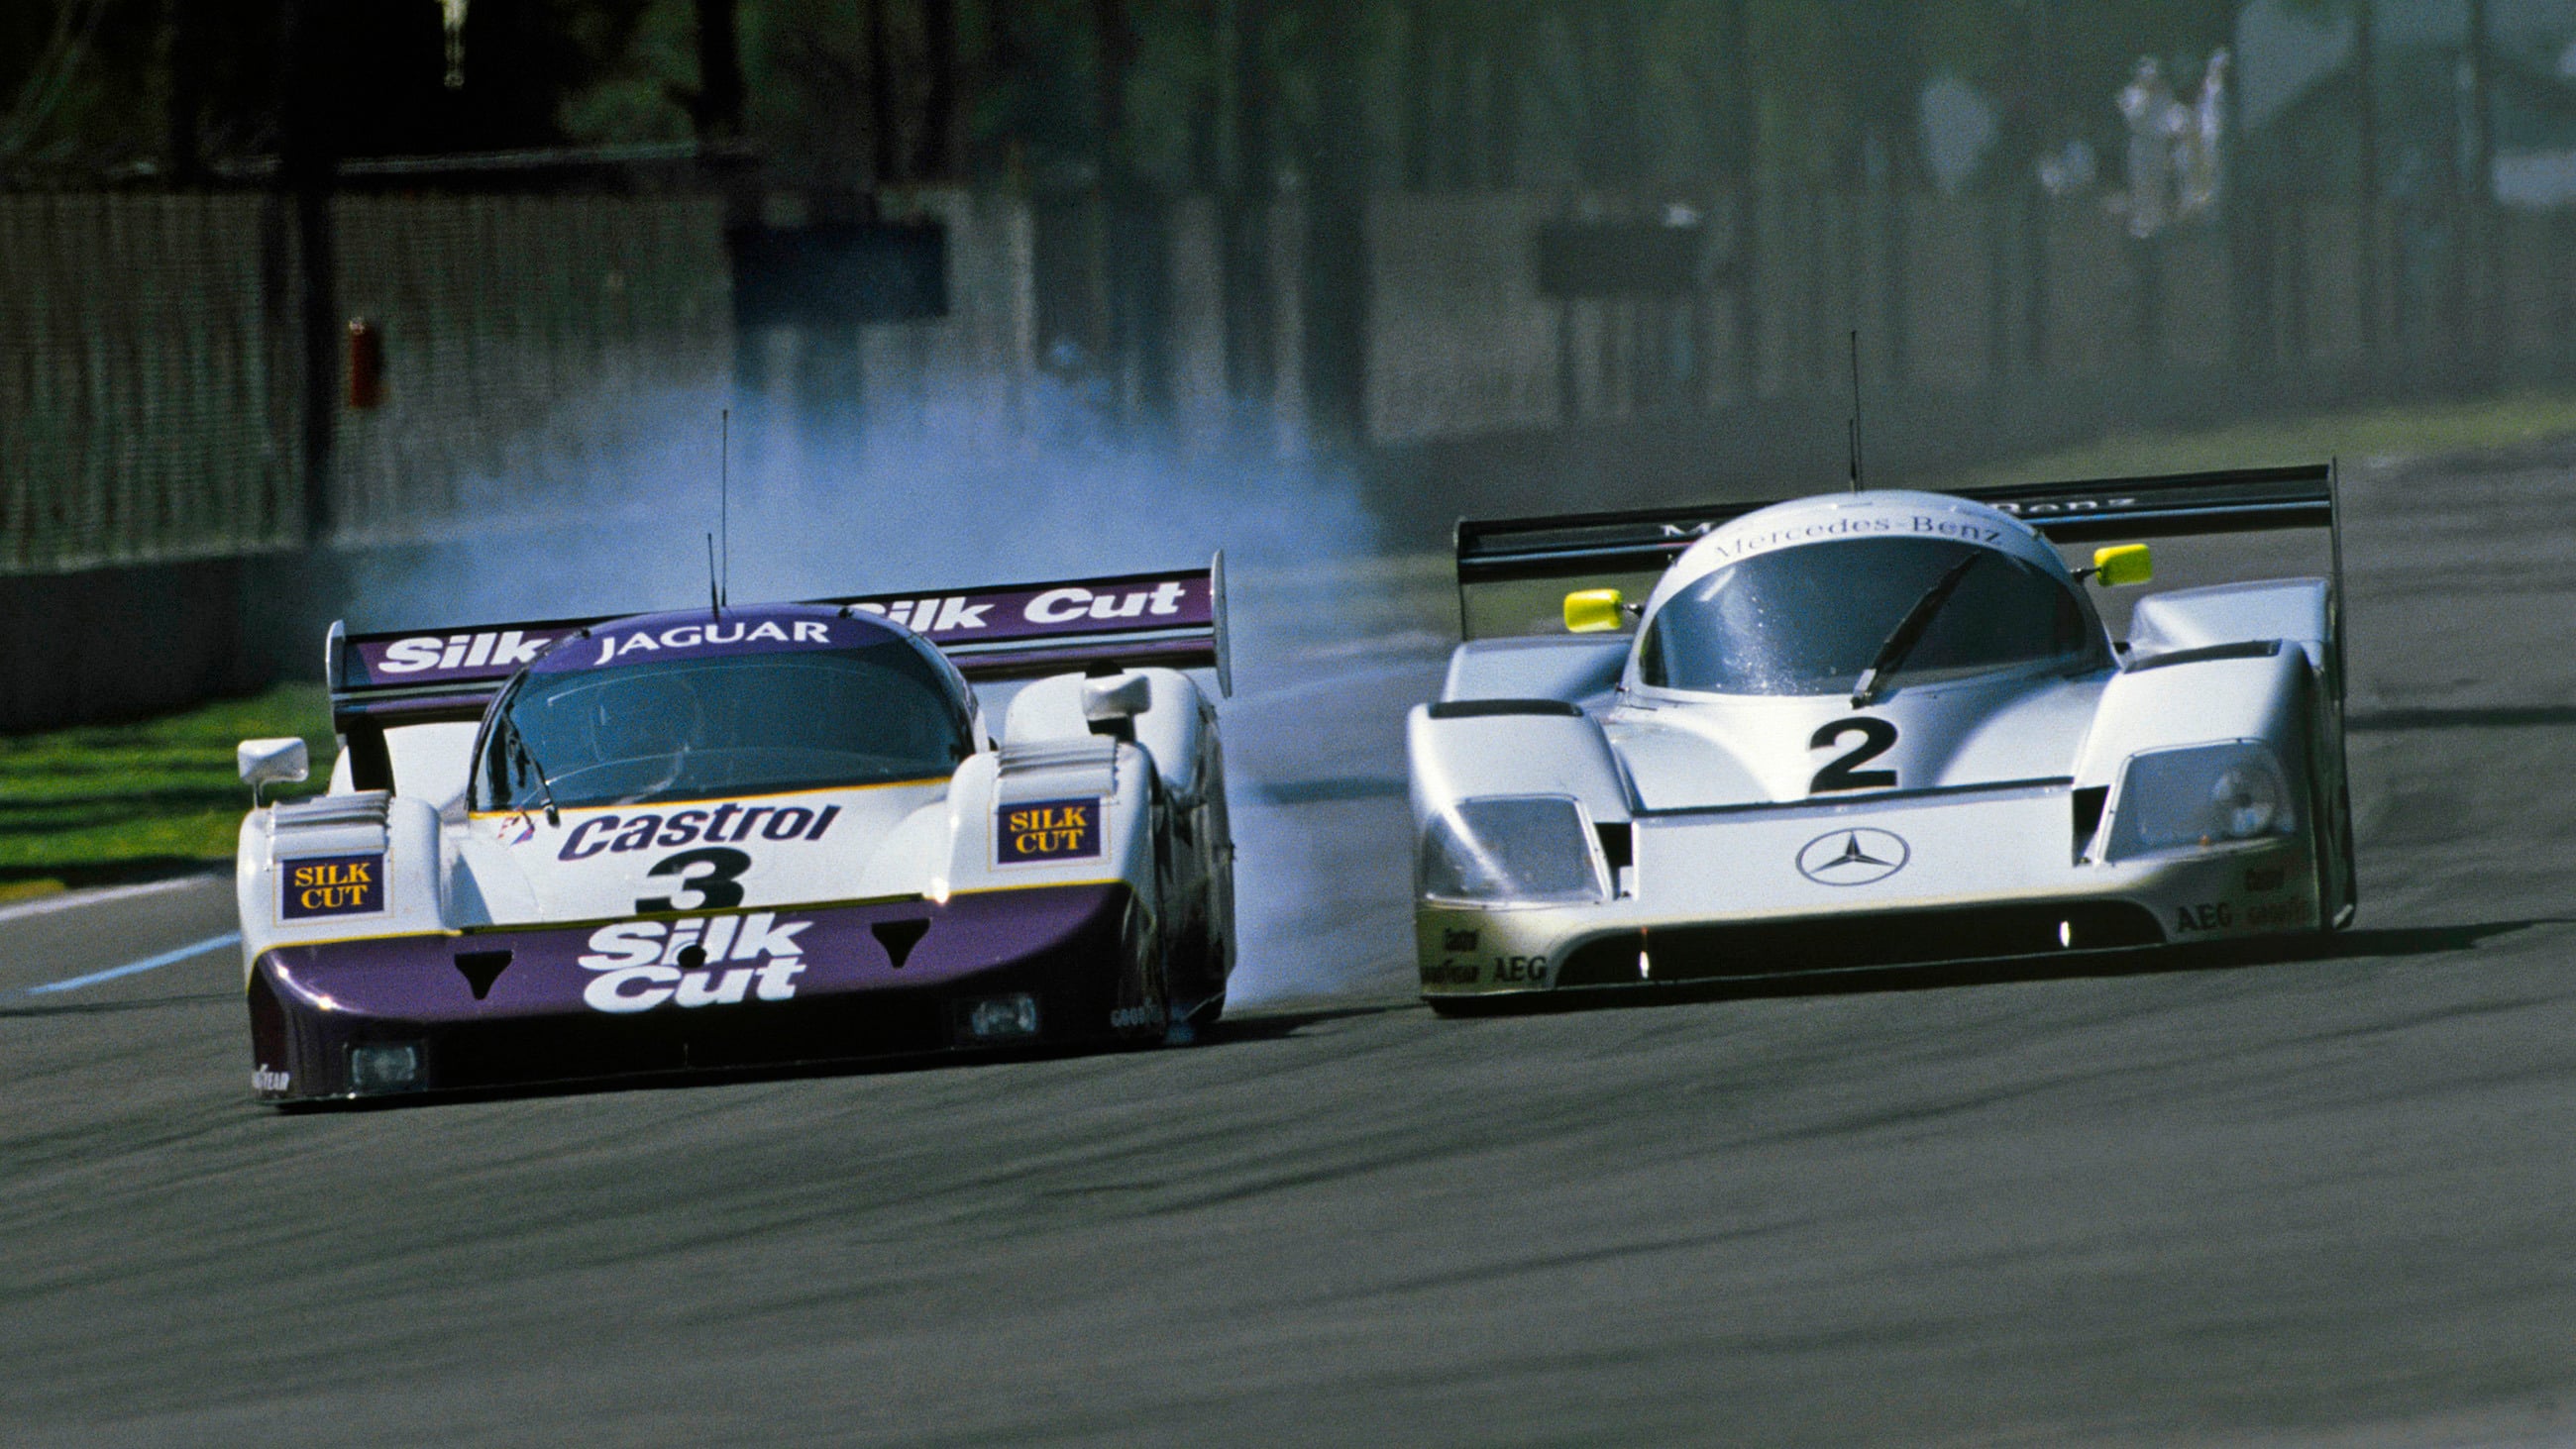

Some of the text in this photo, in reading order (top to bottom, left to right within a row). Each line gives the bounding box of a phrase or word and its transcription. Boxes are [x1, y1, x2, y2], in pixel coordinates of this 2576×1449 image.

[1713, 515, 2001, 560] Mercedes-Benz
[1023, 581, 1186, 624] Cut
[377, 630, 552, 673] Silk
[593, 620, 831, 666] JAGUAR
[1809, 716, 1898, 794] 2
[557, 802, 841, 861] Castrol
[1009, 806, 1088, 832] SILK
[1016, 828, 1085, 855] CUT
[294, 862, 373, 887] SILK
[635, 846, 752, 914] 3
[300, 883, 369, 910] CUT
[2177, 901, 2233, 932] AEG
[578, 912, 815, 971] Silk
[583, 957, 807, 1013] Cut
[1494, 955, 1549, 982] AEG
